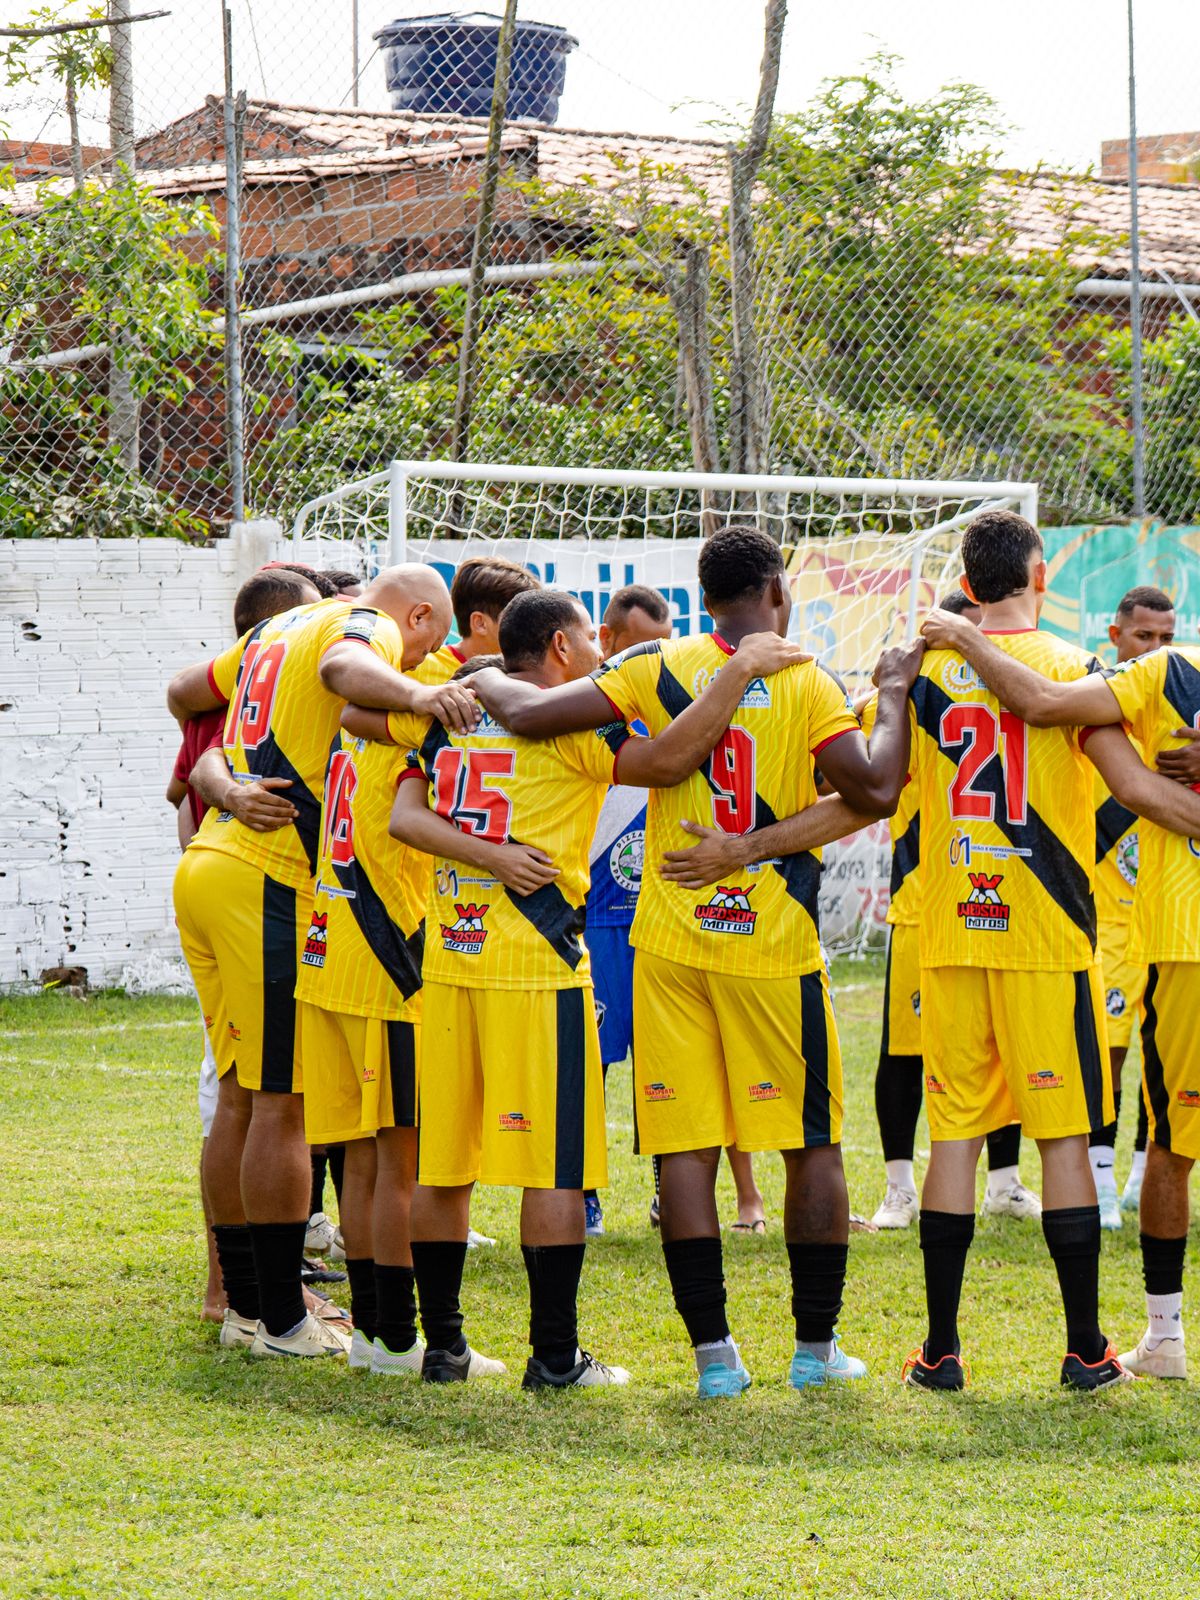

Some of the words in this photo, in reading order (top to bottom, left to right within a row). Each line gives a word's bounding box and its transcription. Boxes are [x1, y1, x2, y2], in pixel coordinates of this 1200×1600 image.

[223, 640, 288, 749] 19
[710, 724, 756, 836] 9
[940, 703, 1028, 826] 21
[432, 746, 516, 845] 15
[695, 905, 757, 922] WEDSON
[703, 919, 752, 933] MOTOS
[968, 918, 1005, 929] MOTOS
[445, 939, 480, 952] MOTOS
